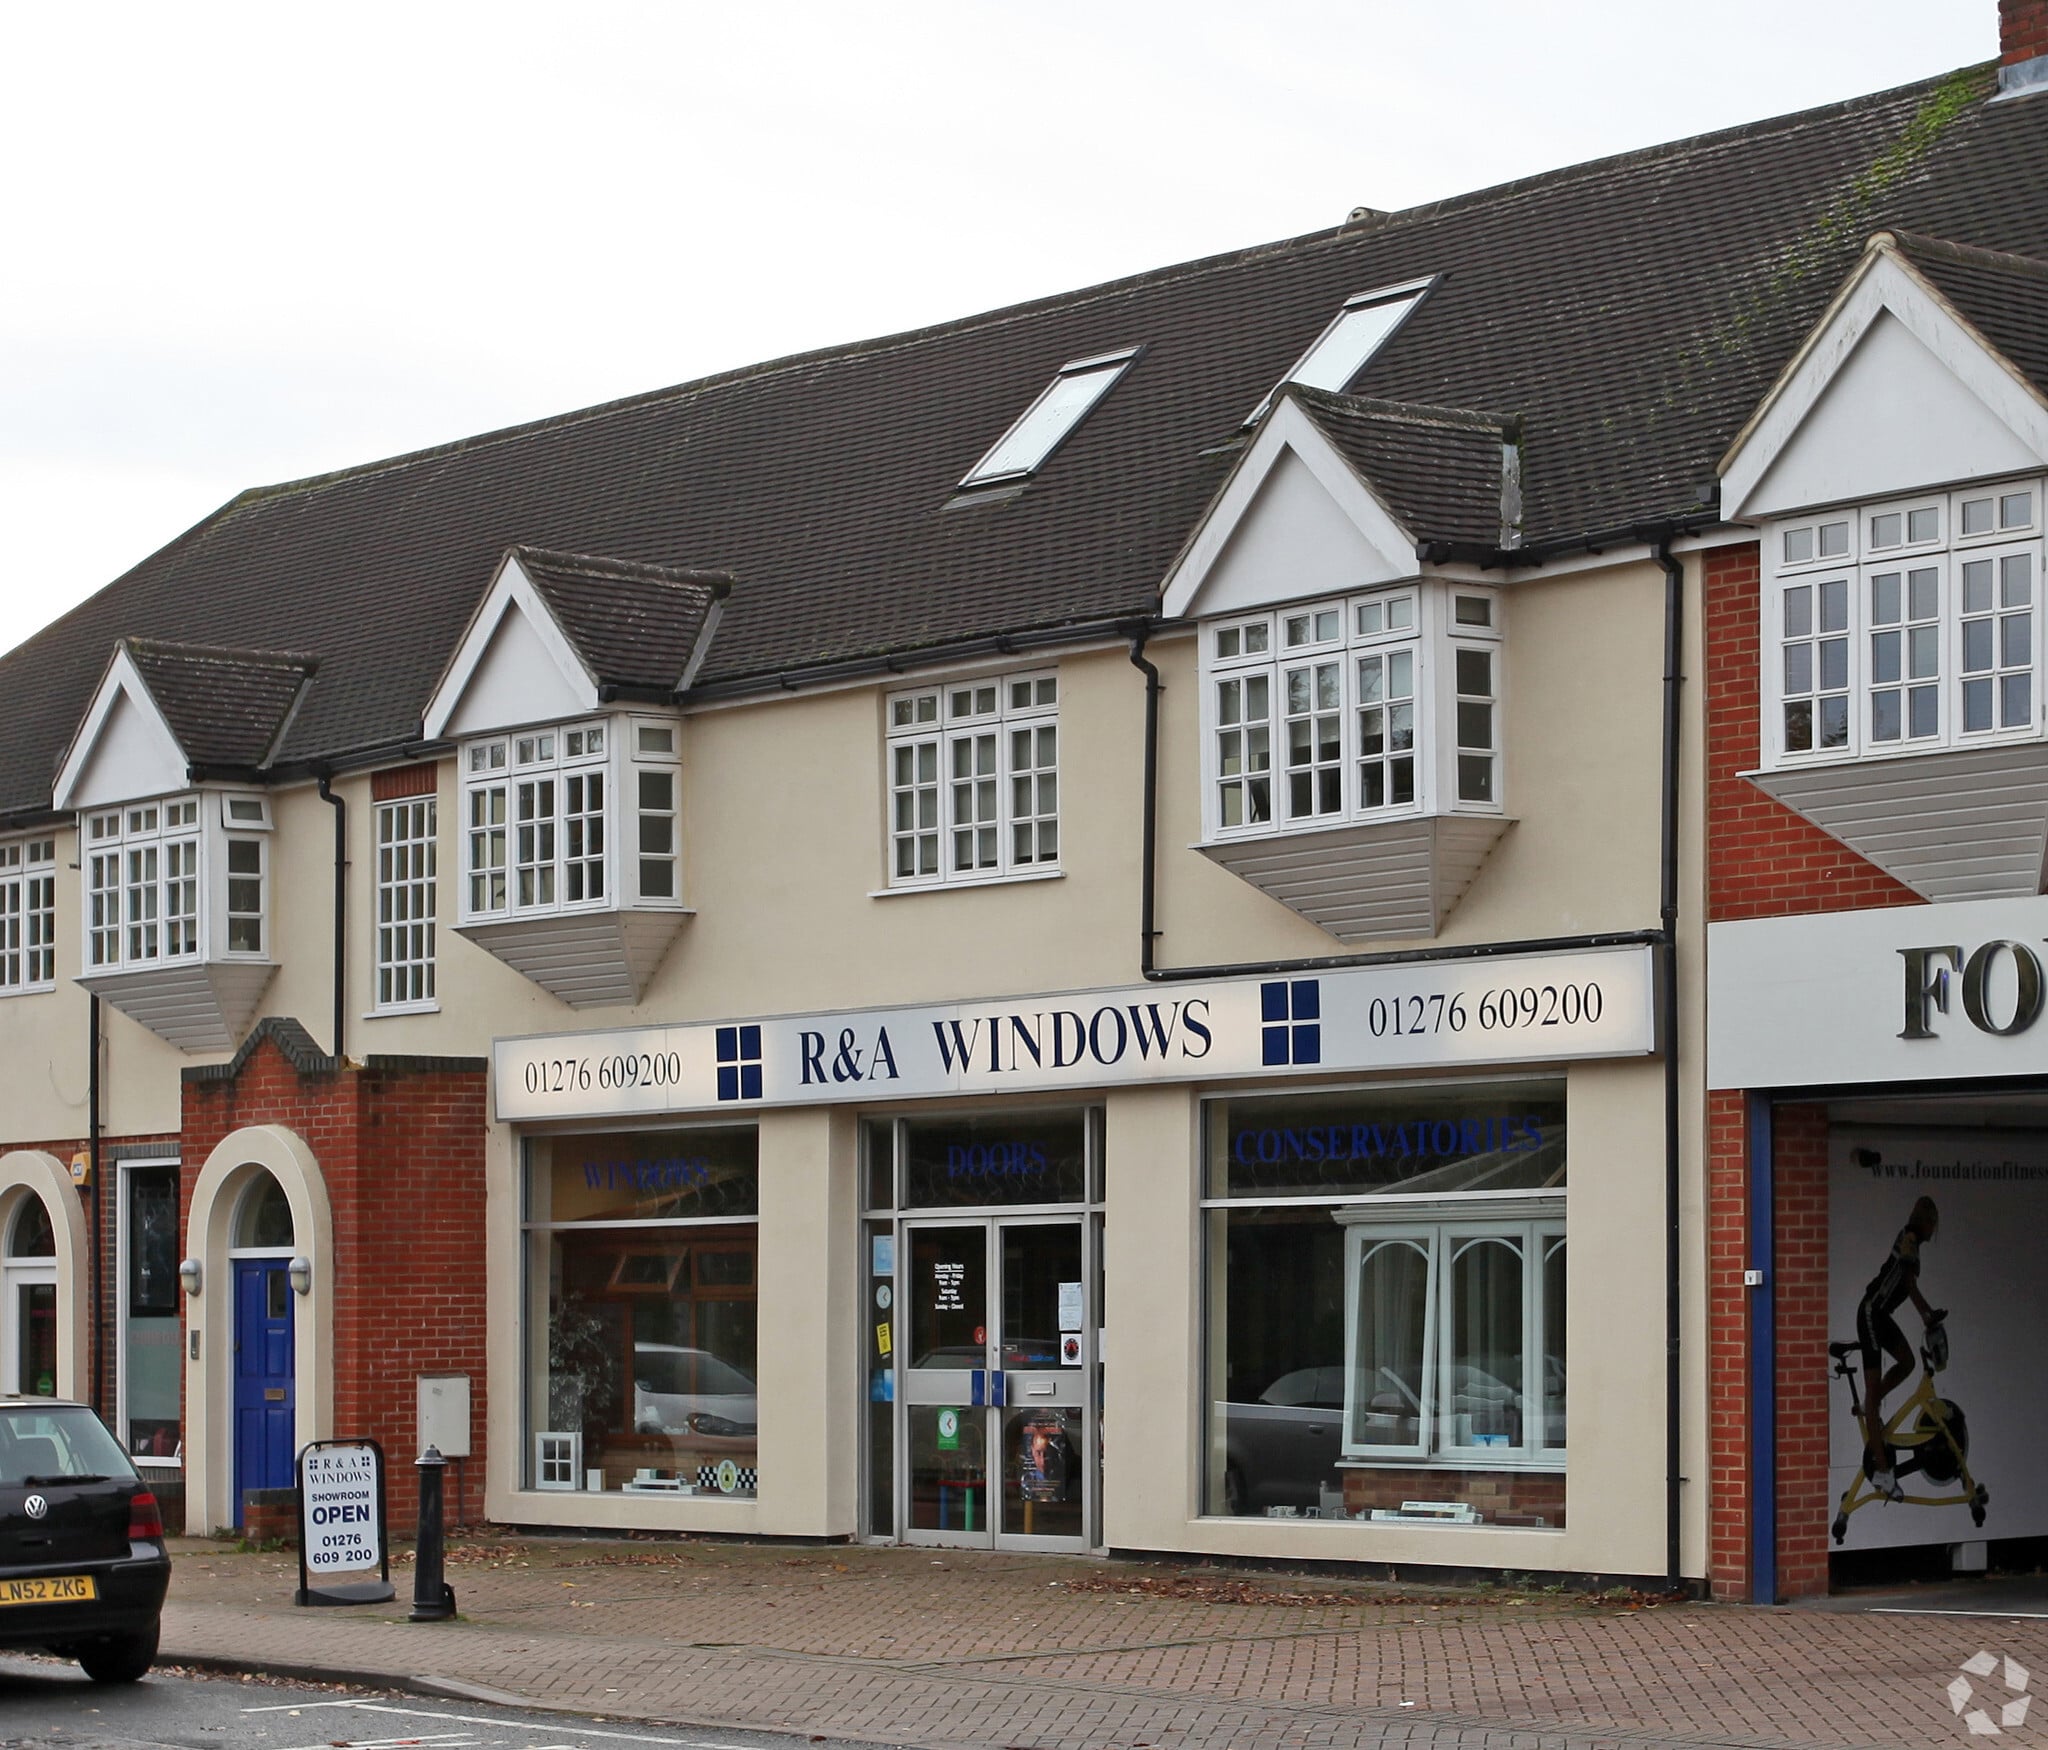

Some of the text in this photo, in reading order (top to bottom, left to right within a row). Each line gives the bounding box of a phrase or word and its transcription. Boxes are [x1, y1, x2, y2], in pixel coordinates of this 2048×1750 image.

[1896, 939, 2048, 1039] FO
[1369, 982, 1603, 1037] 01276 609200
[798, 999, 1212, 1085] R&A WINDOWS
[525, 1051, 681, 1093] 01276 609200
[1235, 1115, 1543, 1166] CONSERVATORIES
[947, 1140, 1047, 1177] DOORS
[583, 1156, 708, 1190] WINDOWS
[323, 1457, 357, 1469] R & A
[310, 1471, 372, 1484] WINDOWS
[312, 1491, 369, 1502] SHOWROOM
[312, 1504, 370, 1525] OPEN
[322, 1533, 362, 1547] 01276
[313, 1549, 372, 1564] 609 200
[0, 1579, 86, 1600] LN52 ZKG
